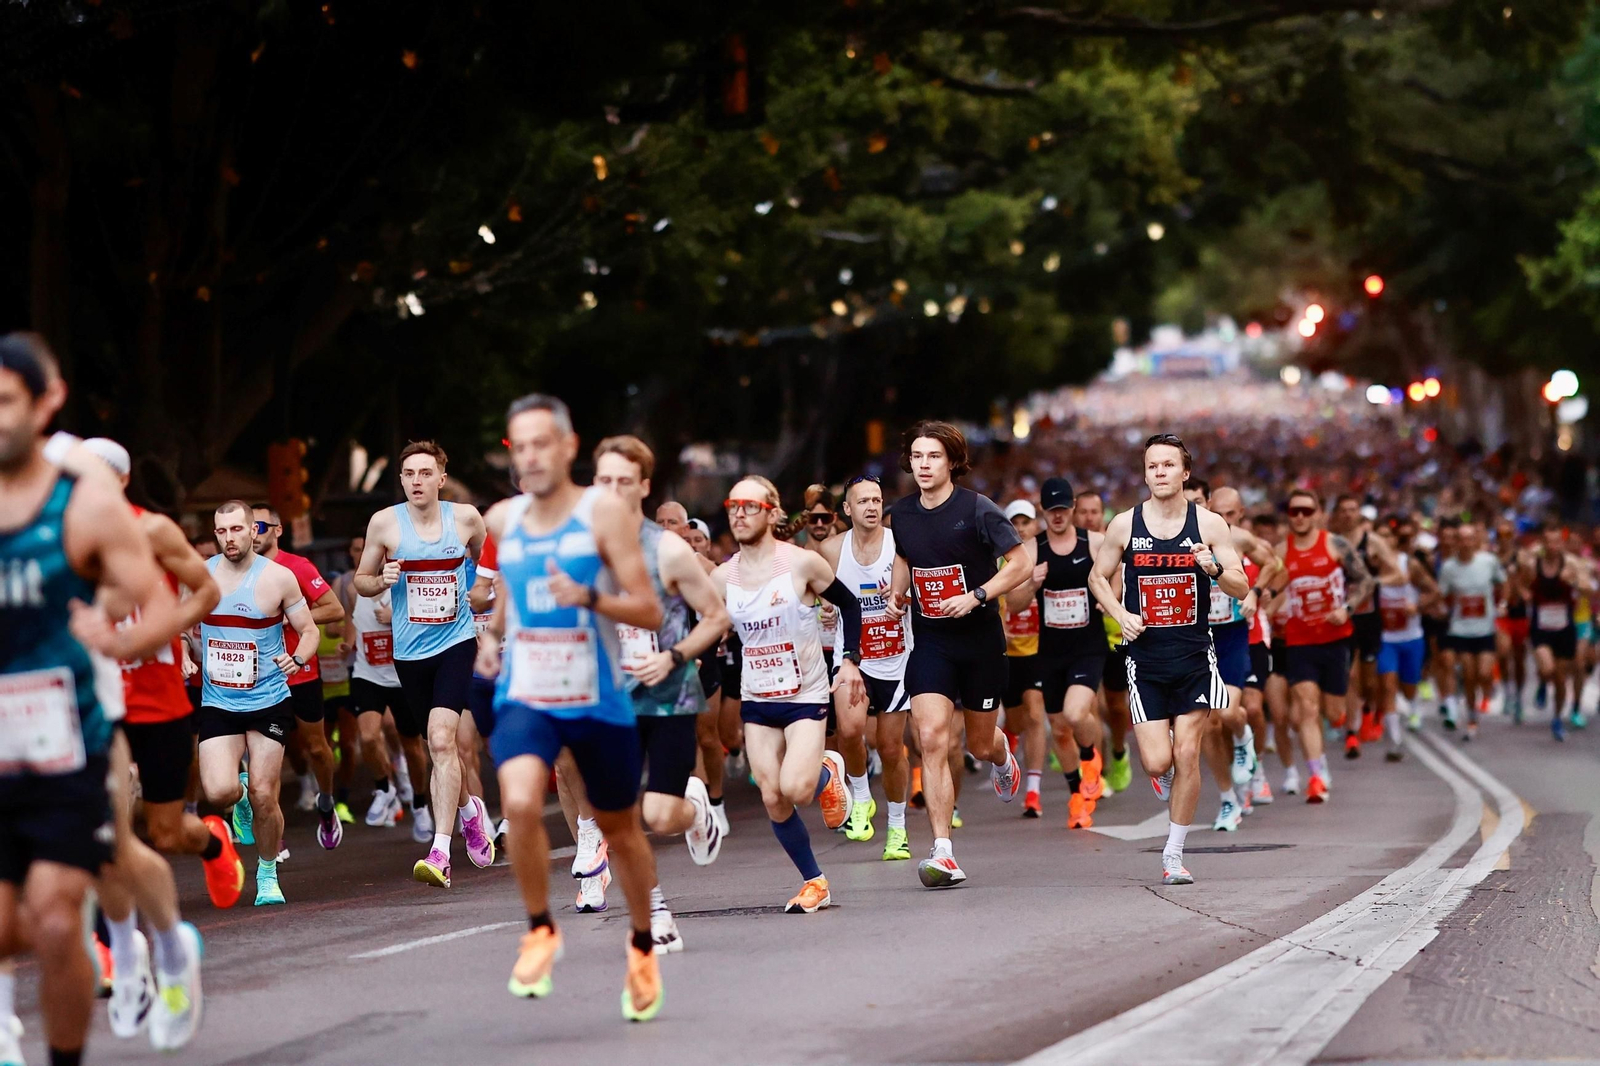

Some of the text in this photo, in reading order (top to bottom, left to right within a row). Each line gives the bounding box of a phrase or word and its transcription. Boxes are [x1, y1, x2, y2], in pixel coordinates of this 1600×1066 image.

[1132, 537, 1153, 549] BRC
[1133, 553, 1195, 567] BETTER
[922, 568, 954, 578] GENERALI
[420, 576, 452, 584] GENERALI
[1152, 576, 1187, 585] GENERALI
[924, 581, 945, 591] 523
[417, 587, 448, 597] 15524
[1155, 588, 1176, 599] 510
[742, 615, 781, 632] TARGET
[867, 625, 886, 636] 475
[219, 641, 250, 650] GENERALI
[749, 643, 786, 656] GENERALI
[216, 651, 245, 662] 14828
[749, 657, 783, 670] 15345
[834, 777, 847, 811] KIPRUN
